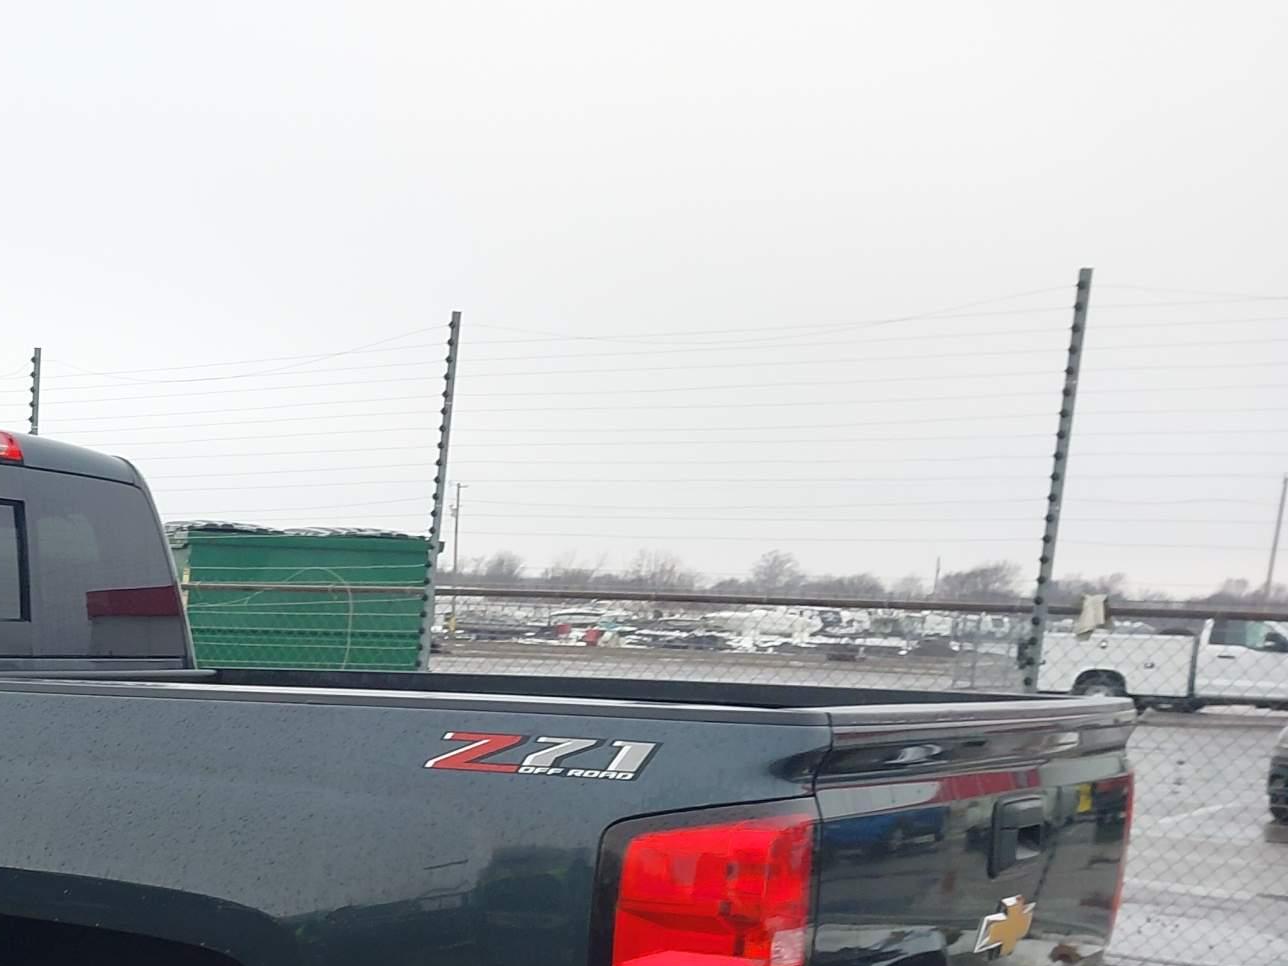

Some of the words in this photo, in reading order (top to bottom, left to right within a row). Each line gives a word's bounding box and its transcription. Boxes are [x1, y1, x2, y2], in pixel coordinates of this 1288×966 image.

[424, 731, 657, 773] Z71
[518, 766, 564, 775] OFF
[567, 770, 634, 780] ROAD
